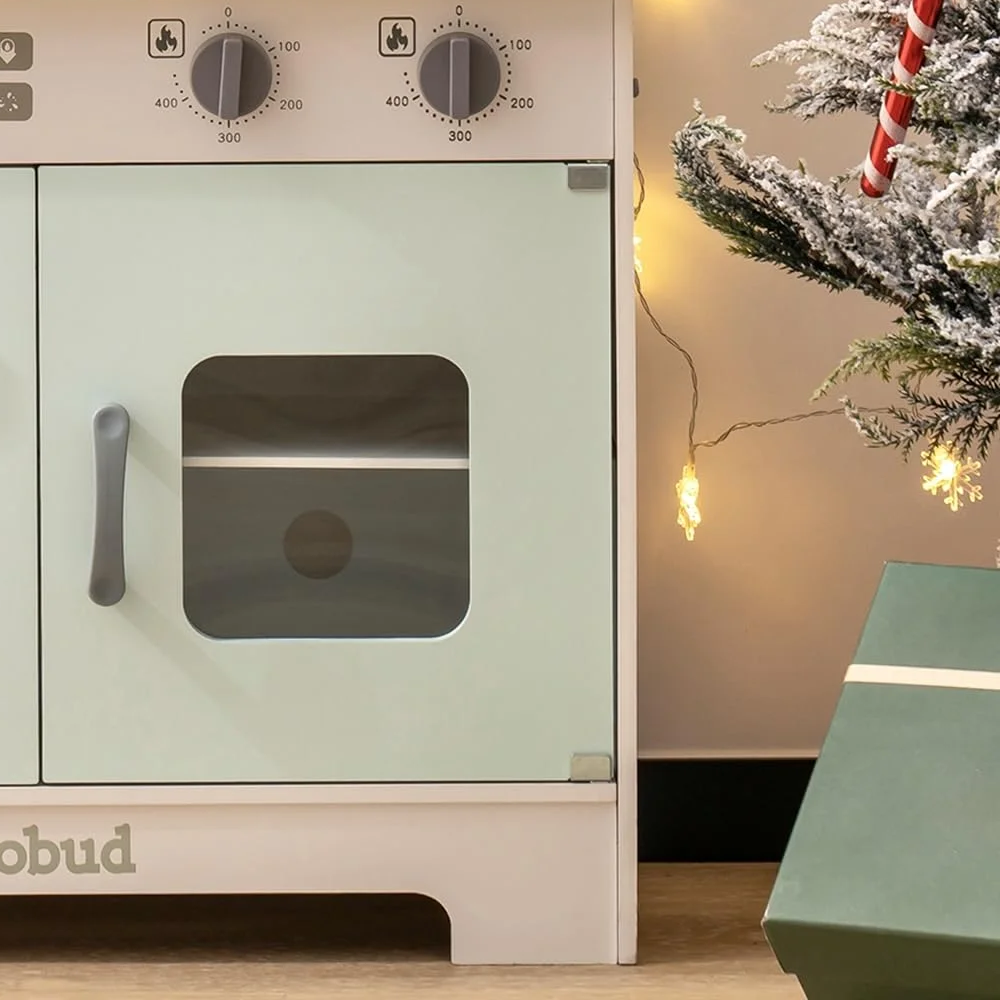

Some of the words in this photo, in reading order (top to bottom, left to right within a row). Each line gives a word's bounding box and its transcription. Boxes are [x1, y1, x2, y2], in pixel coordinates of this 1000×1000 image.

[224, 7, 232, 17] 0
[455, 5, 463, 16] 0
[279, 41, 301, 52] 100
[510, 39, 532, 50] 100
[155, 98, 178, 109] 400
[280, 99, 303, 110] 200
[385, 96, 409, 107] 400
[511, 98, 534, 109] 200
[217, 132, 241, 143] 300
[448, 131, 472, 142] 300
